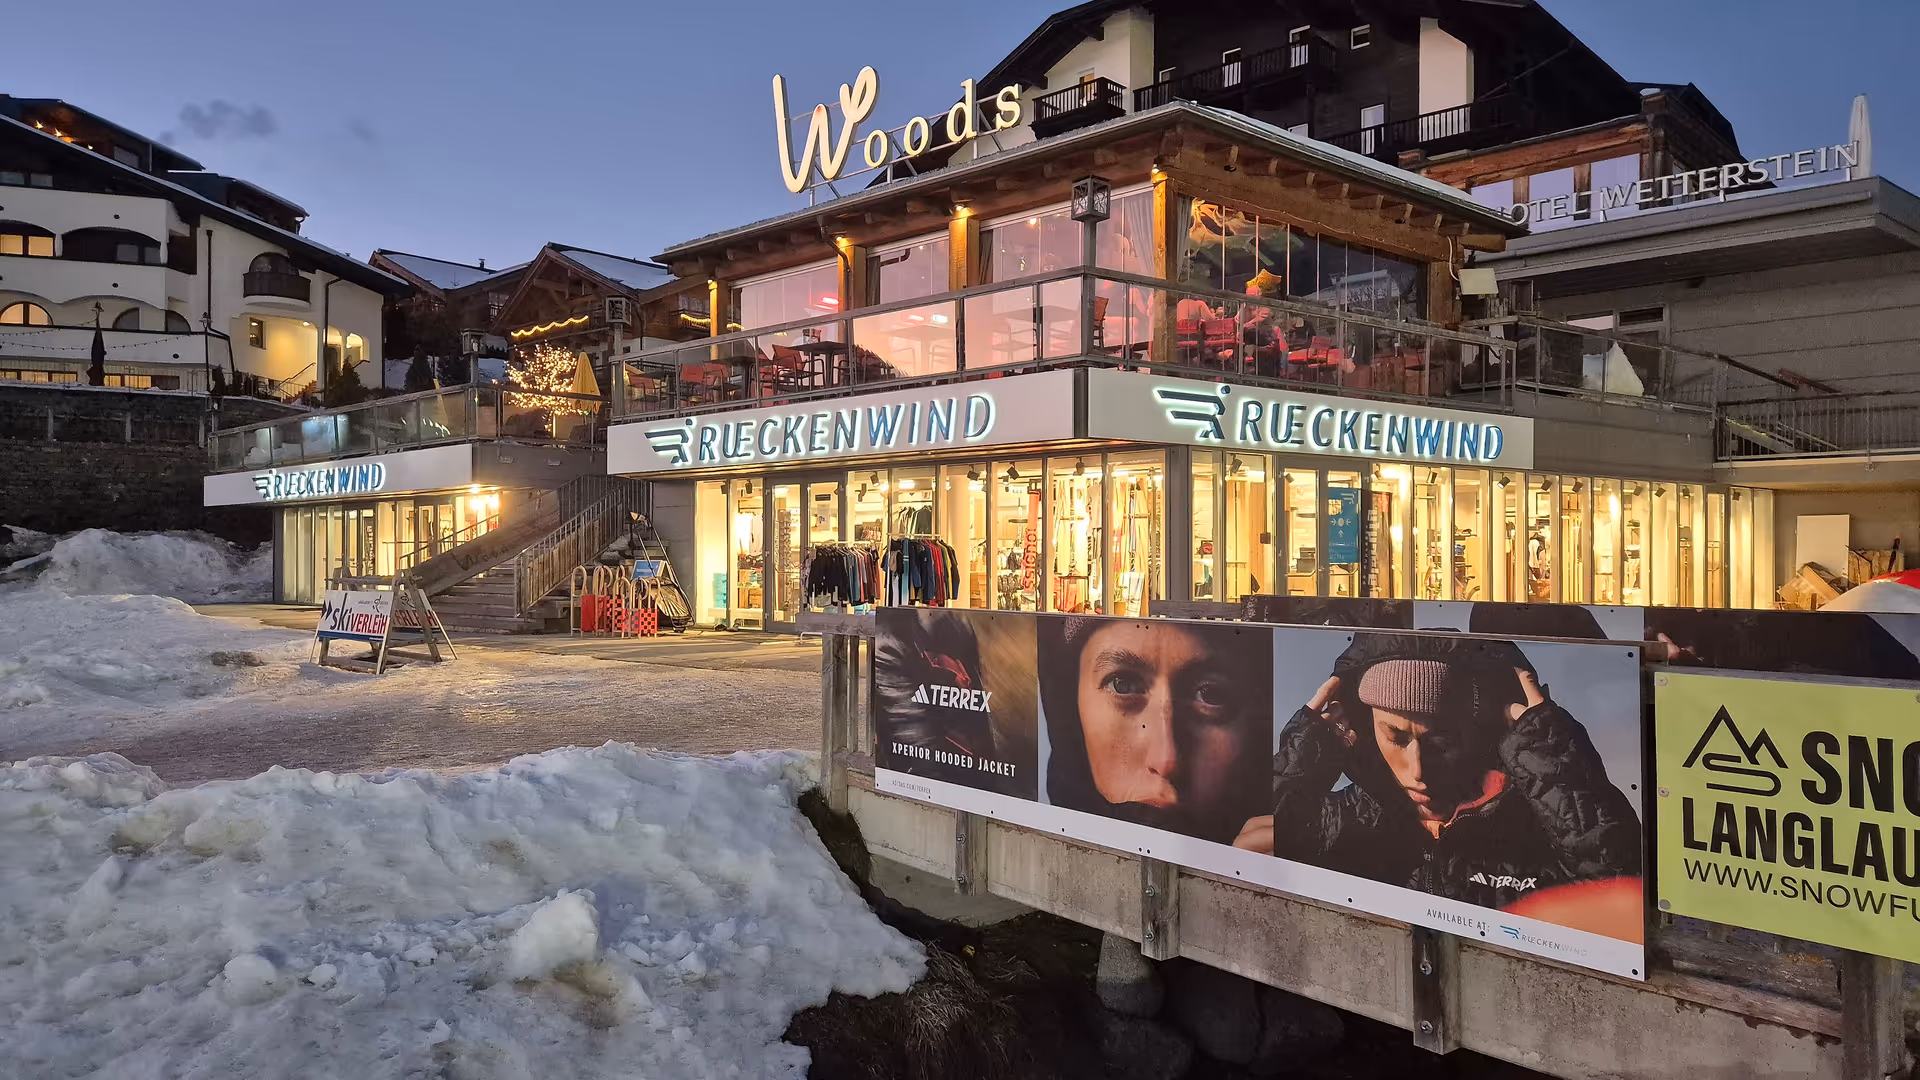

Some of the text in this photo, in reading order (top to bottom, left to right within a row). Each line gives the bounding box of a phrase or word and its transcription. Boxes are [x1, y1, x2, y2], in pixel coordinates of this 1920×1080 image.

[772, 65, 1023, 194] Woods
[1498, 140, 1860, 226] OTEL WETTERSTEIN
[698, 394, 996, 462] RUECKENWIND
[1237, 398, 1504, 461] RUECKENWIND
[930, 684, 993, 713] TERREX
[892, 742, 1016, 777] XPERIOR HOODED JACKET
[1488, 874, 1538, 892] TERREX
[1426, 908, 1473, 928] AVAILABLE
[1476, 920, 1490, 932] AT:
